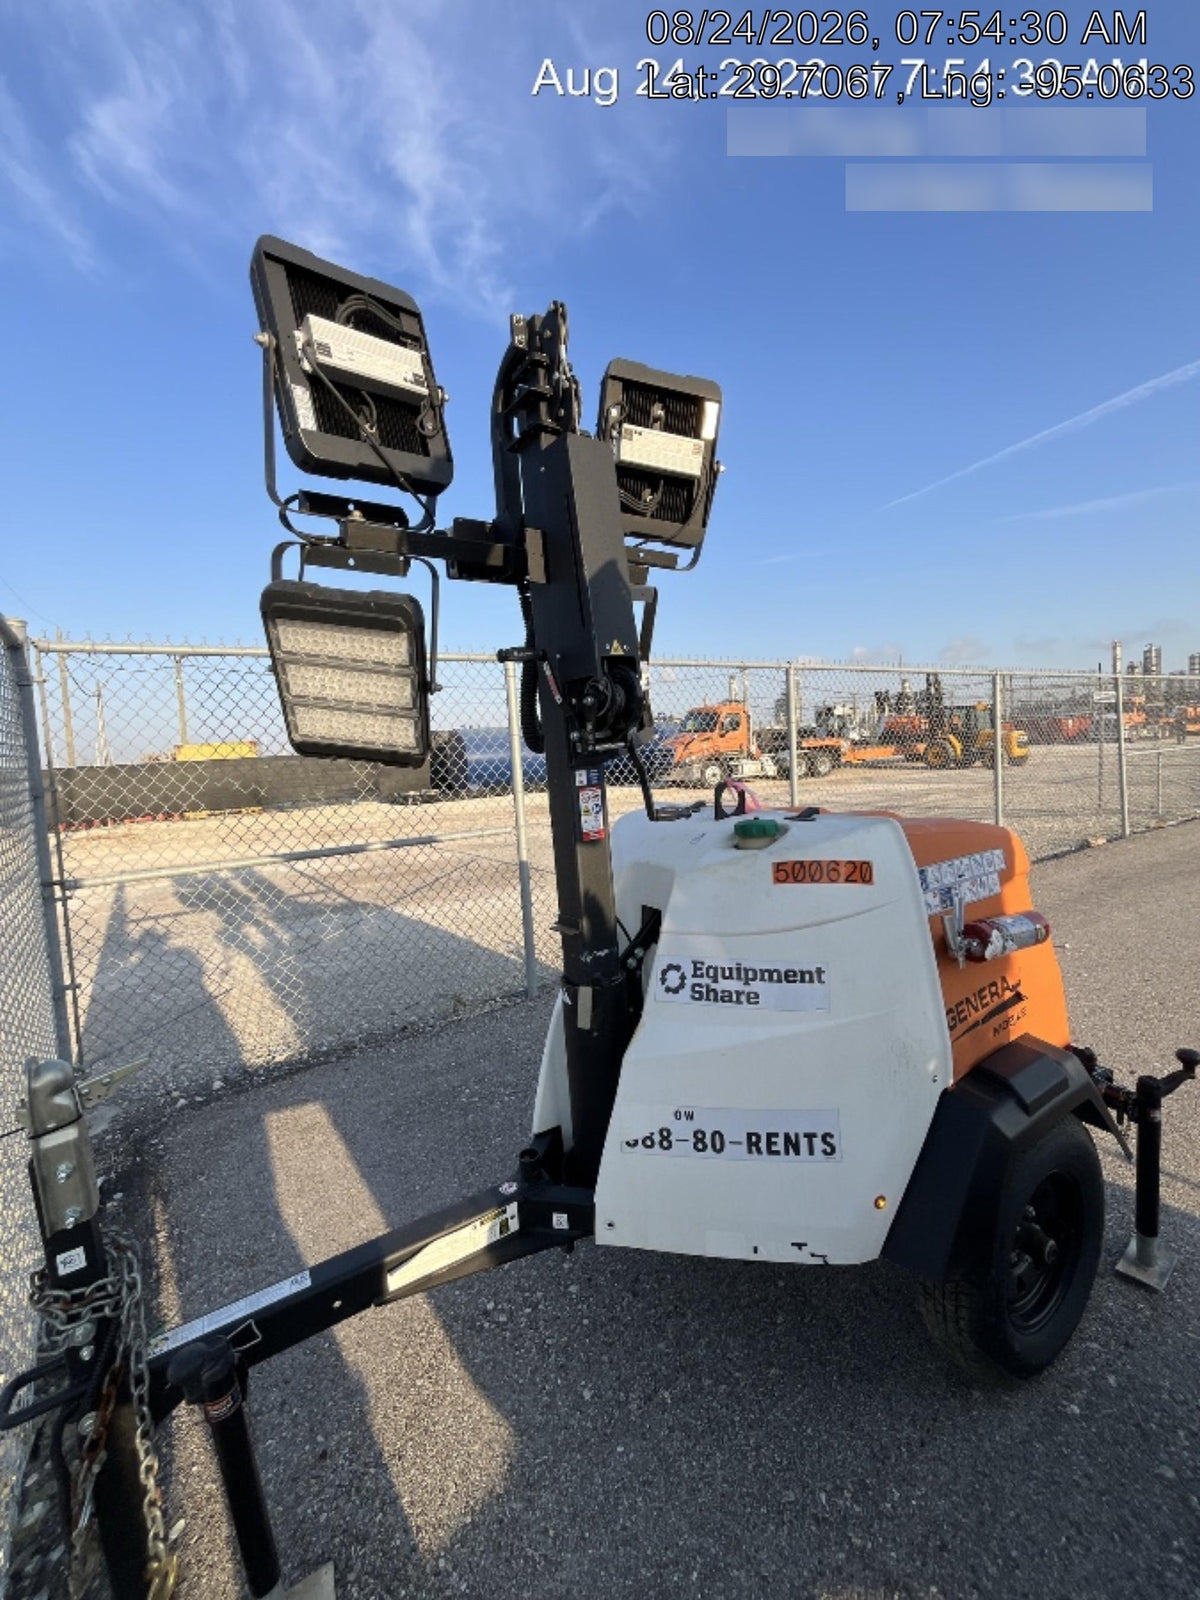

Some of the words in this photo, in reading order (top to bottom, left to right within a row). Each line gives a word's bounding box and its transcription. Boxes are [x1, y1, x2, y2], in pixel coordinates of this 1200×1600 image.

[774, 861, 874, 883] 500620
[691, 960, 826, 985] Equipment
[690, 983, 760, 1005] Share
